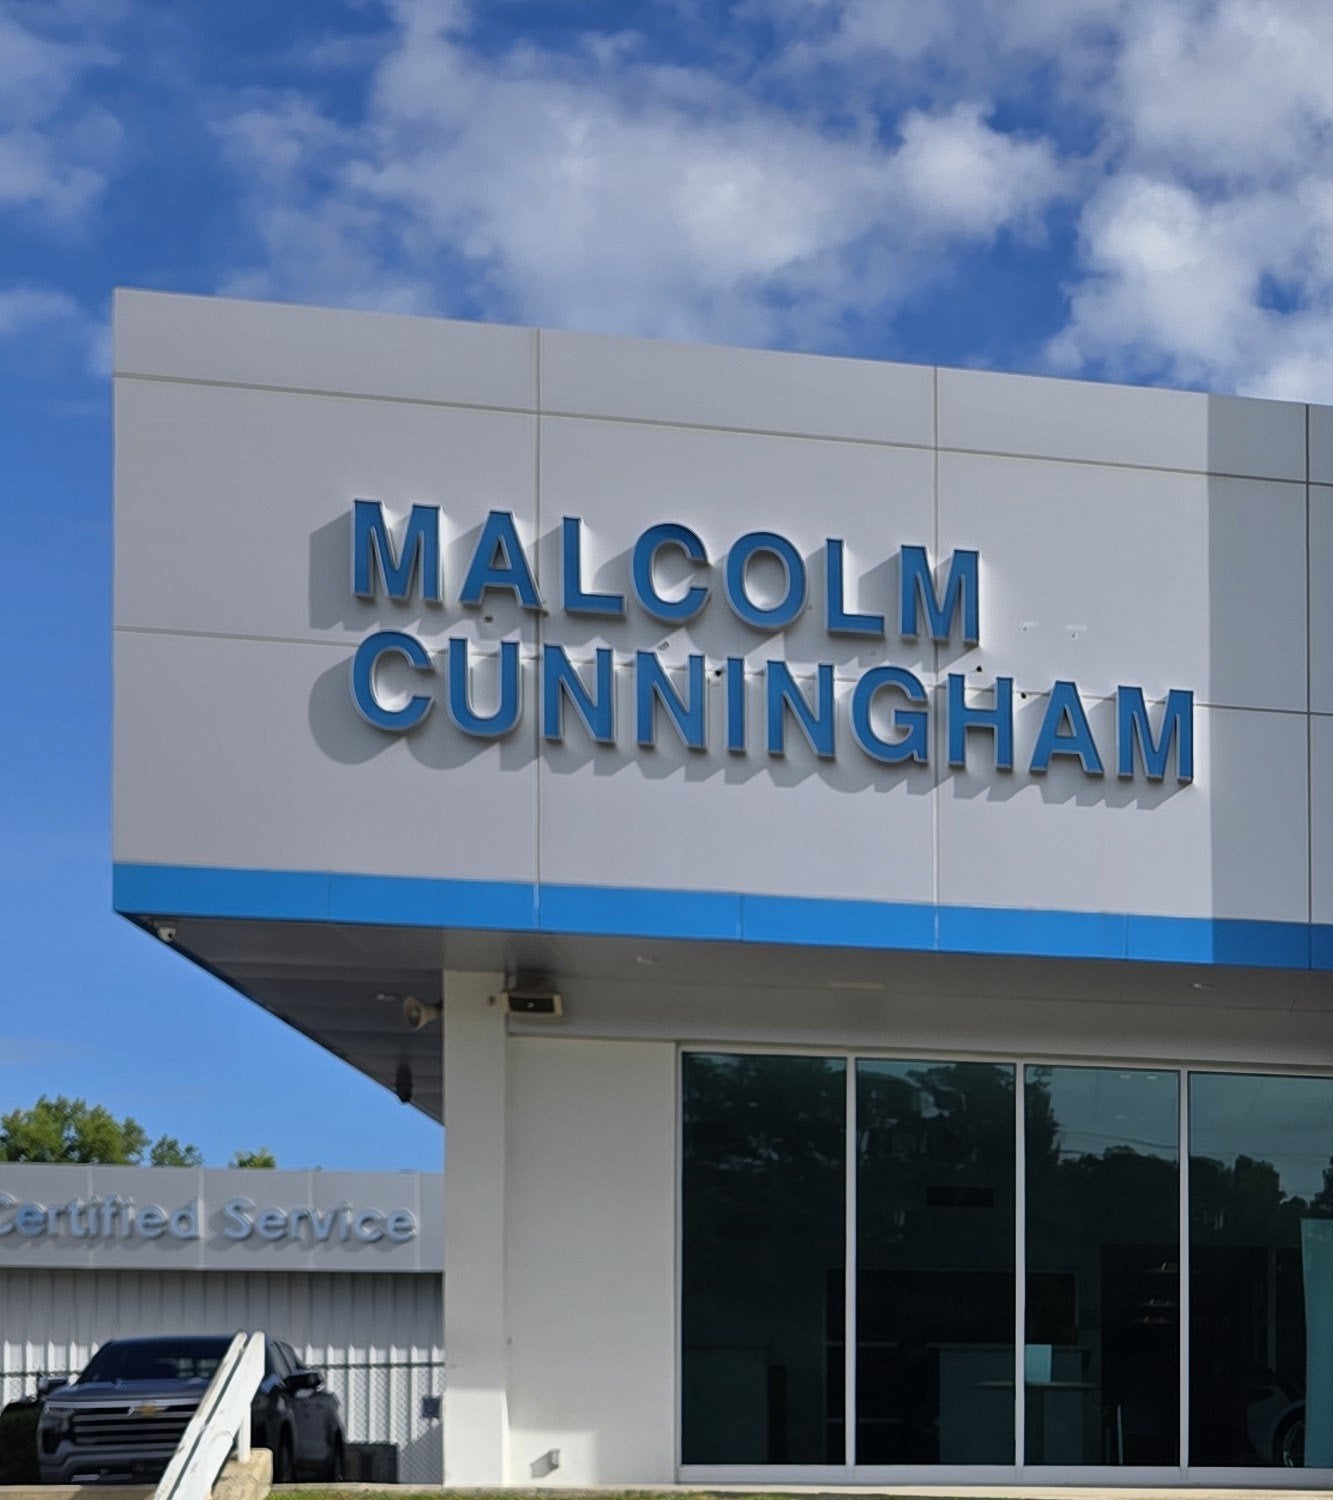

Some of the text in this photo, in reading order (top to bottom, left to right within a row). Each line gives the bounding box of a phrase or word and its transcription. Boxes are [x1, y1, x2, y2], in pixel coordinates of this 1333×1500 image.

[351, 498, 979, 646] MALCOLM
[351, 628, 1194, 784] CUNNINGHAM
[222, 1197, 417, 1242] Service
